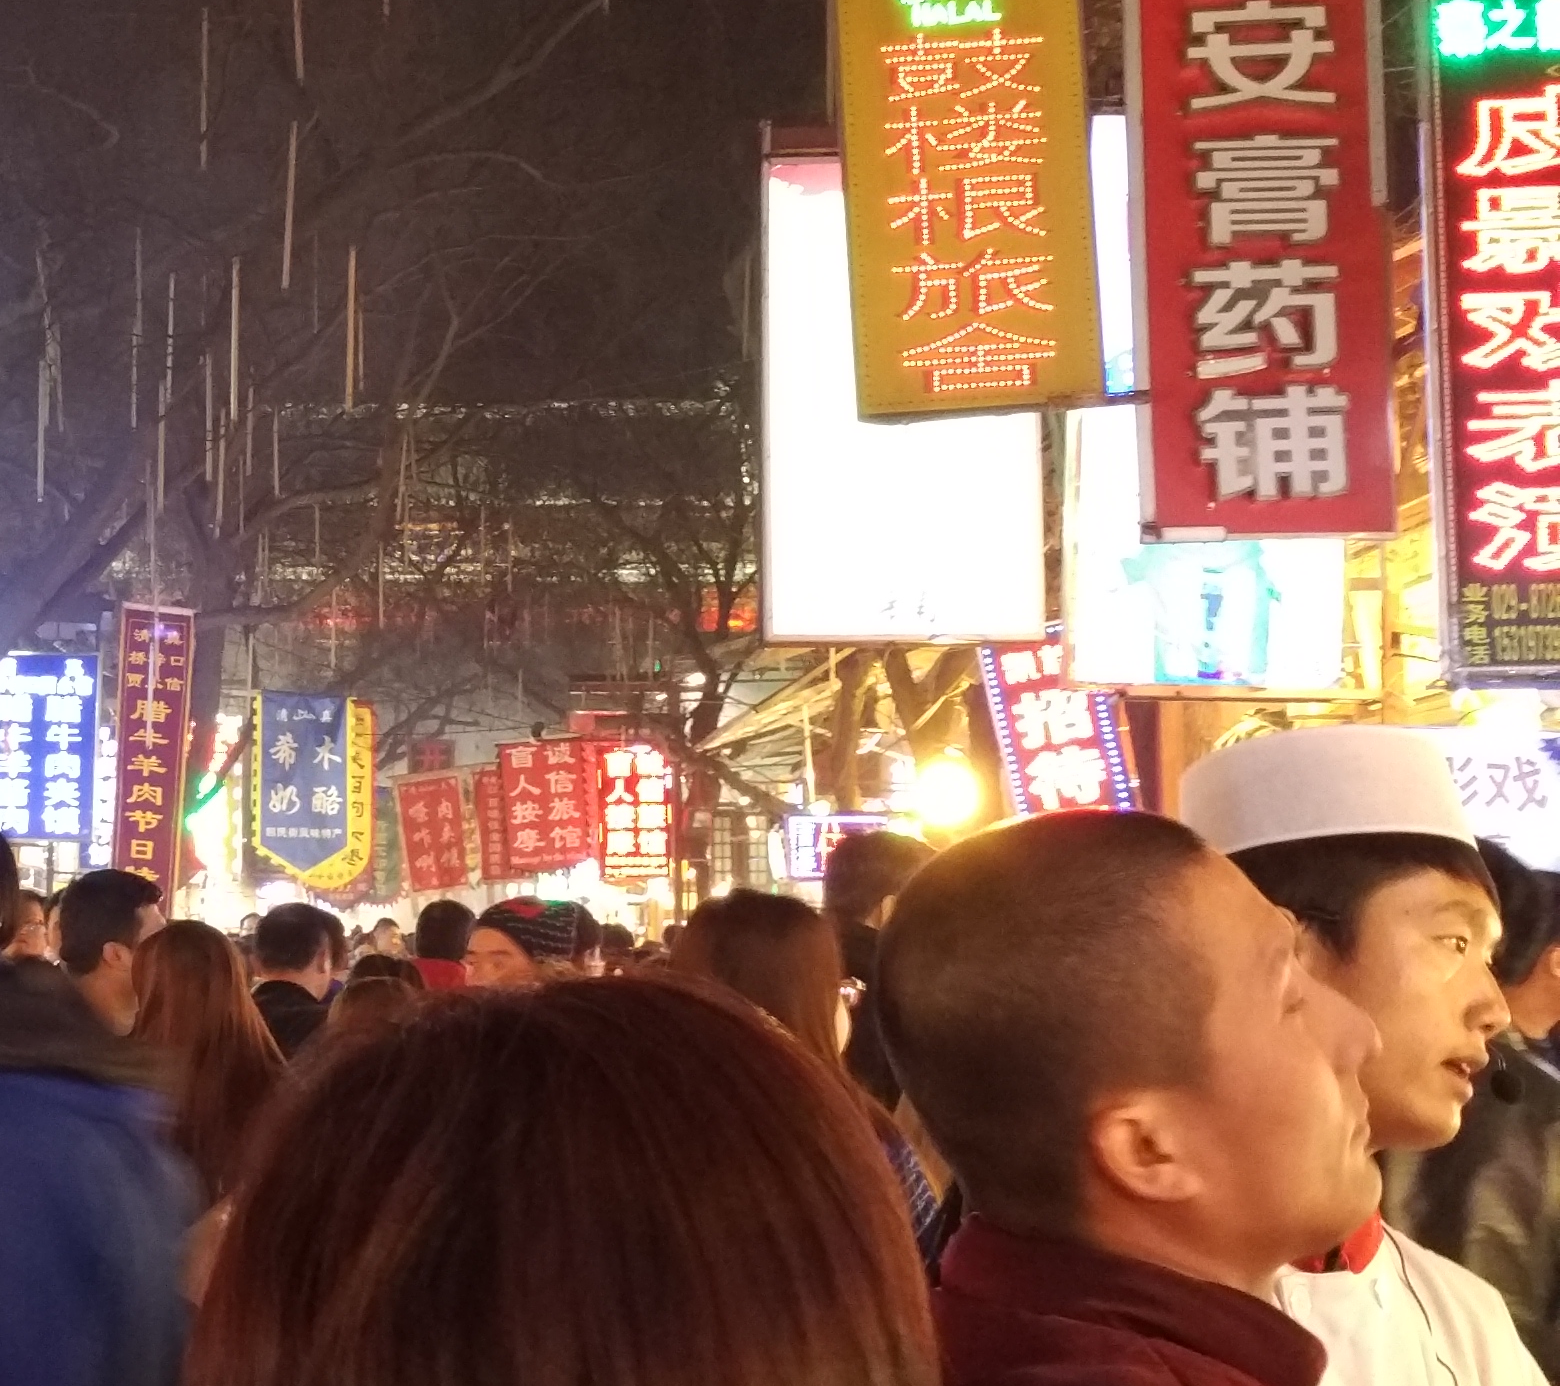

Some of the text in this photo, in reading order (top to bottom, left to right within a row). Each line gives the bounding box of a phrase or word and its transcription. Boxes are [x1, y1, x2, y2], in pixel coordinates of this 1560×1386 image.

[910, 0, 1003, 27] HALAL
[880, 28, 1057, 393] 鼓楼根旅舍
[1462, 582, 1491, 665] 业务电话
[268, 782, 344, 816] 奶酪
[505, 745, 546, 853] 盲人按摩
[543, 742, 583, 849] 诚信旅馆
